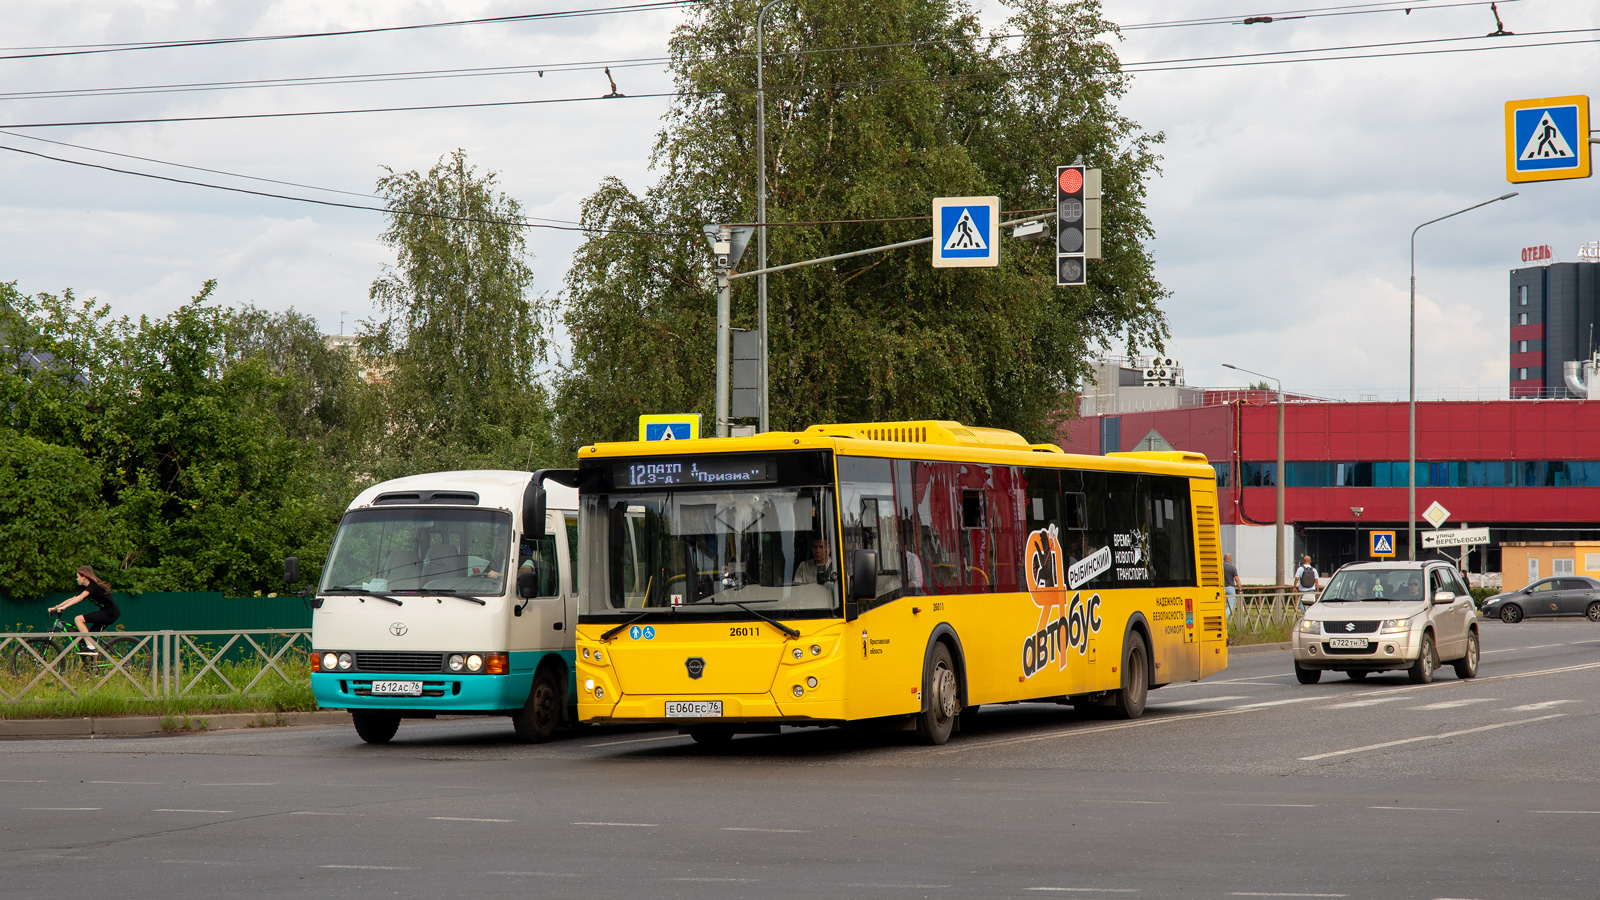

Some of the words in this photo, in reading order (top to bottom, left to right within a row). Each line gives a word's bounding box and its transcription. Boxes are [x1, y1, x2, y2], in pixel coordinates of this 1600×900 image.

[1521, 245, 1551, 262] ОТЕЛЬ
[647, 463, 682, 474] ПАТП
[691, 462, 699, 473] 1
[630, 465, 646, 485] 12
[1113, 533, 1132, 547] ВРЕМЯ
[1436, 536, 1487, 545] ВЕРЕТЬЕВСКАЯ
[1114, 550, 1135, 564] НОВОГО
[1069, 548, 1110, 586] РЫБИНСКИЙ
[1116, 567, 1149, 580] ТРАНСПОРТА
[1155, 597, 1184, 608] НАДЕЖНОСТЬ
[1153, 611, 1184, 621] БЕЗОПАСНОСТЬ
[729, 627, 760, 637] 26011
[1164, 625, 1184, 635] КОМФОРТ
